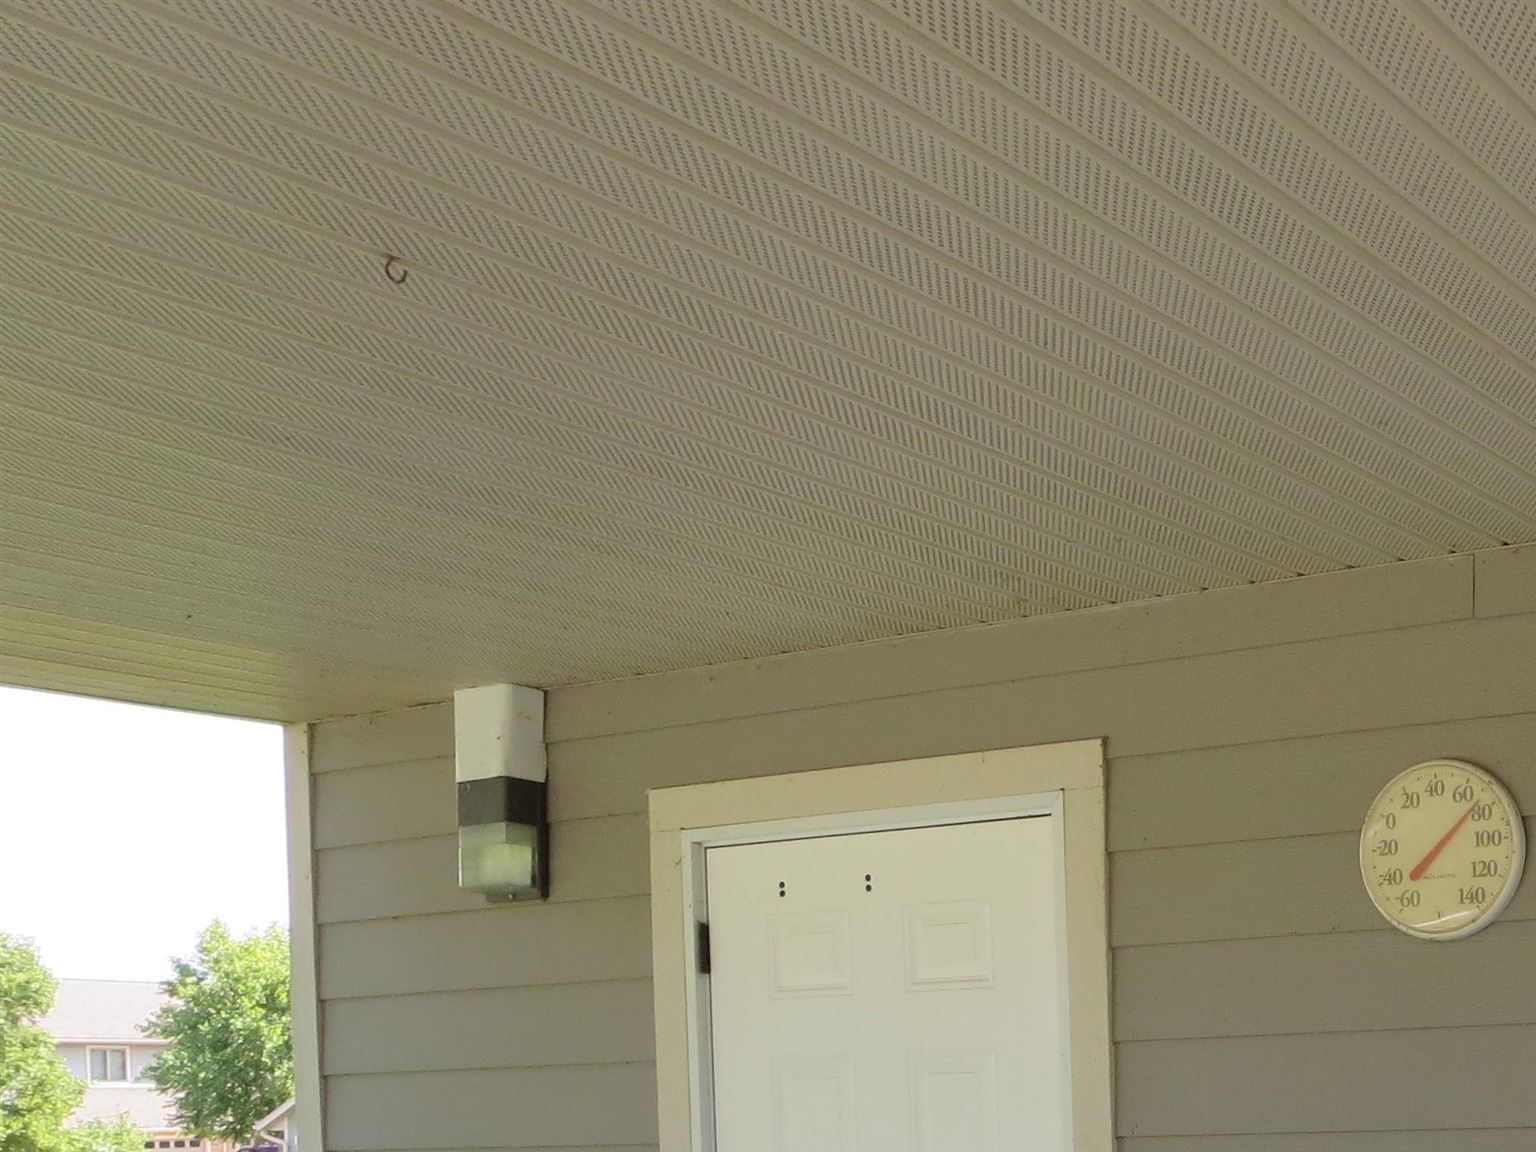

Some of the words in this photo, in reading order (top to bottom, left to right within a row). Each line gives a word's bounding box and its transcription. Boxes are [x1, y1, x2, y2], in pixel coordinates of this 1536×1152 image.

[1425, 780, 1445, 797] 40
[1453, 785, 1474, 802] 60
[1401, 792, 1420, 808] 20
[1385, 813, 1396, 829] 0
[1471, 804, 1493, 821] 80
[1474, 830, 1502, 847] 100
[1471, 860, 1498, 877] 120
[1459, 887, 1485, 904] 140
